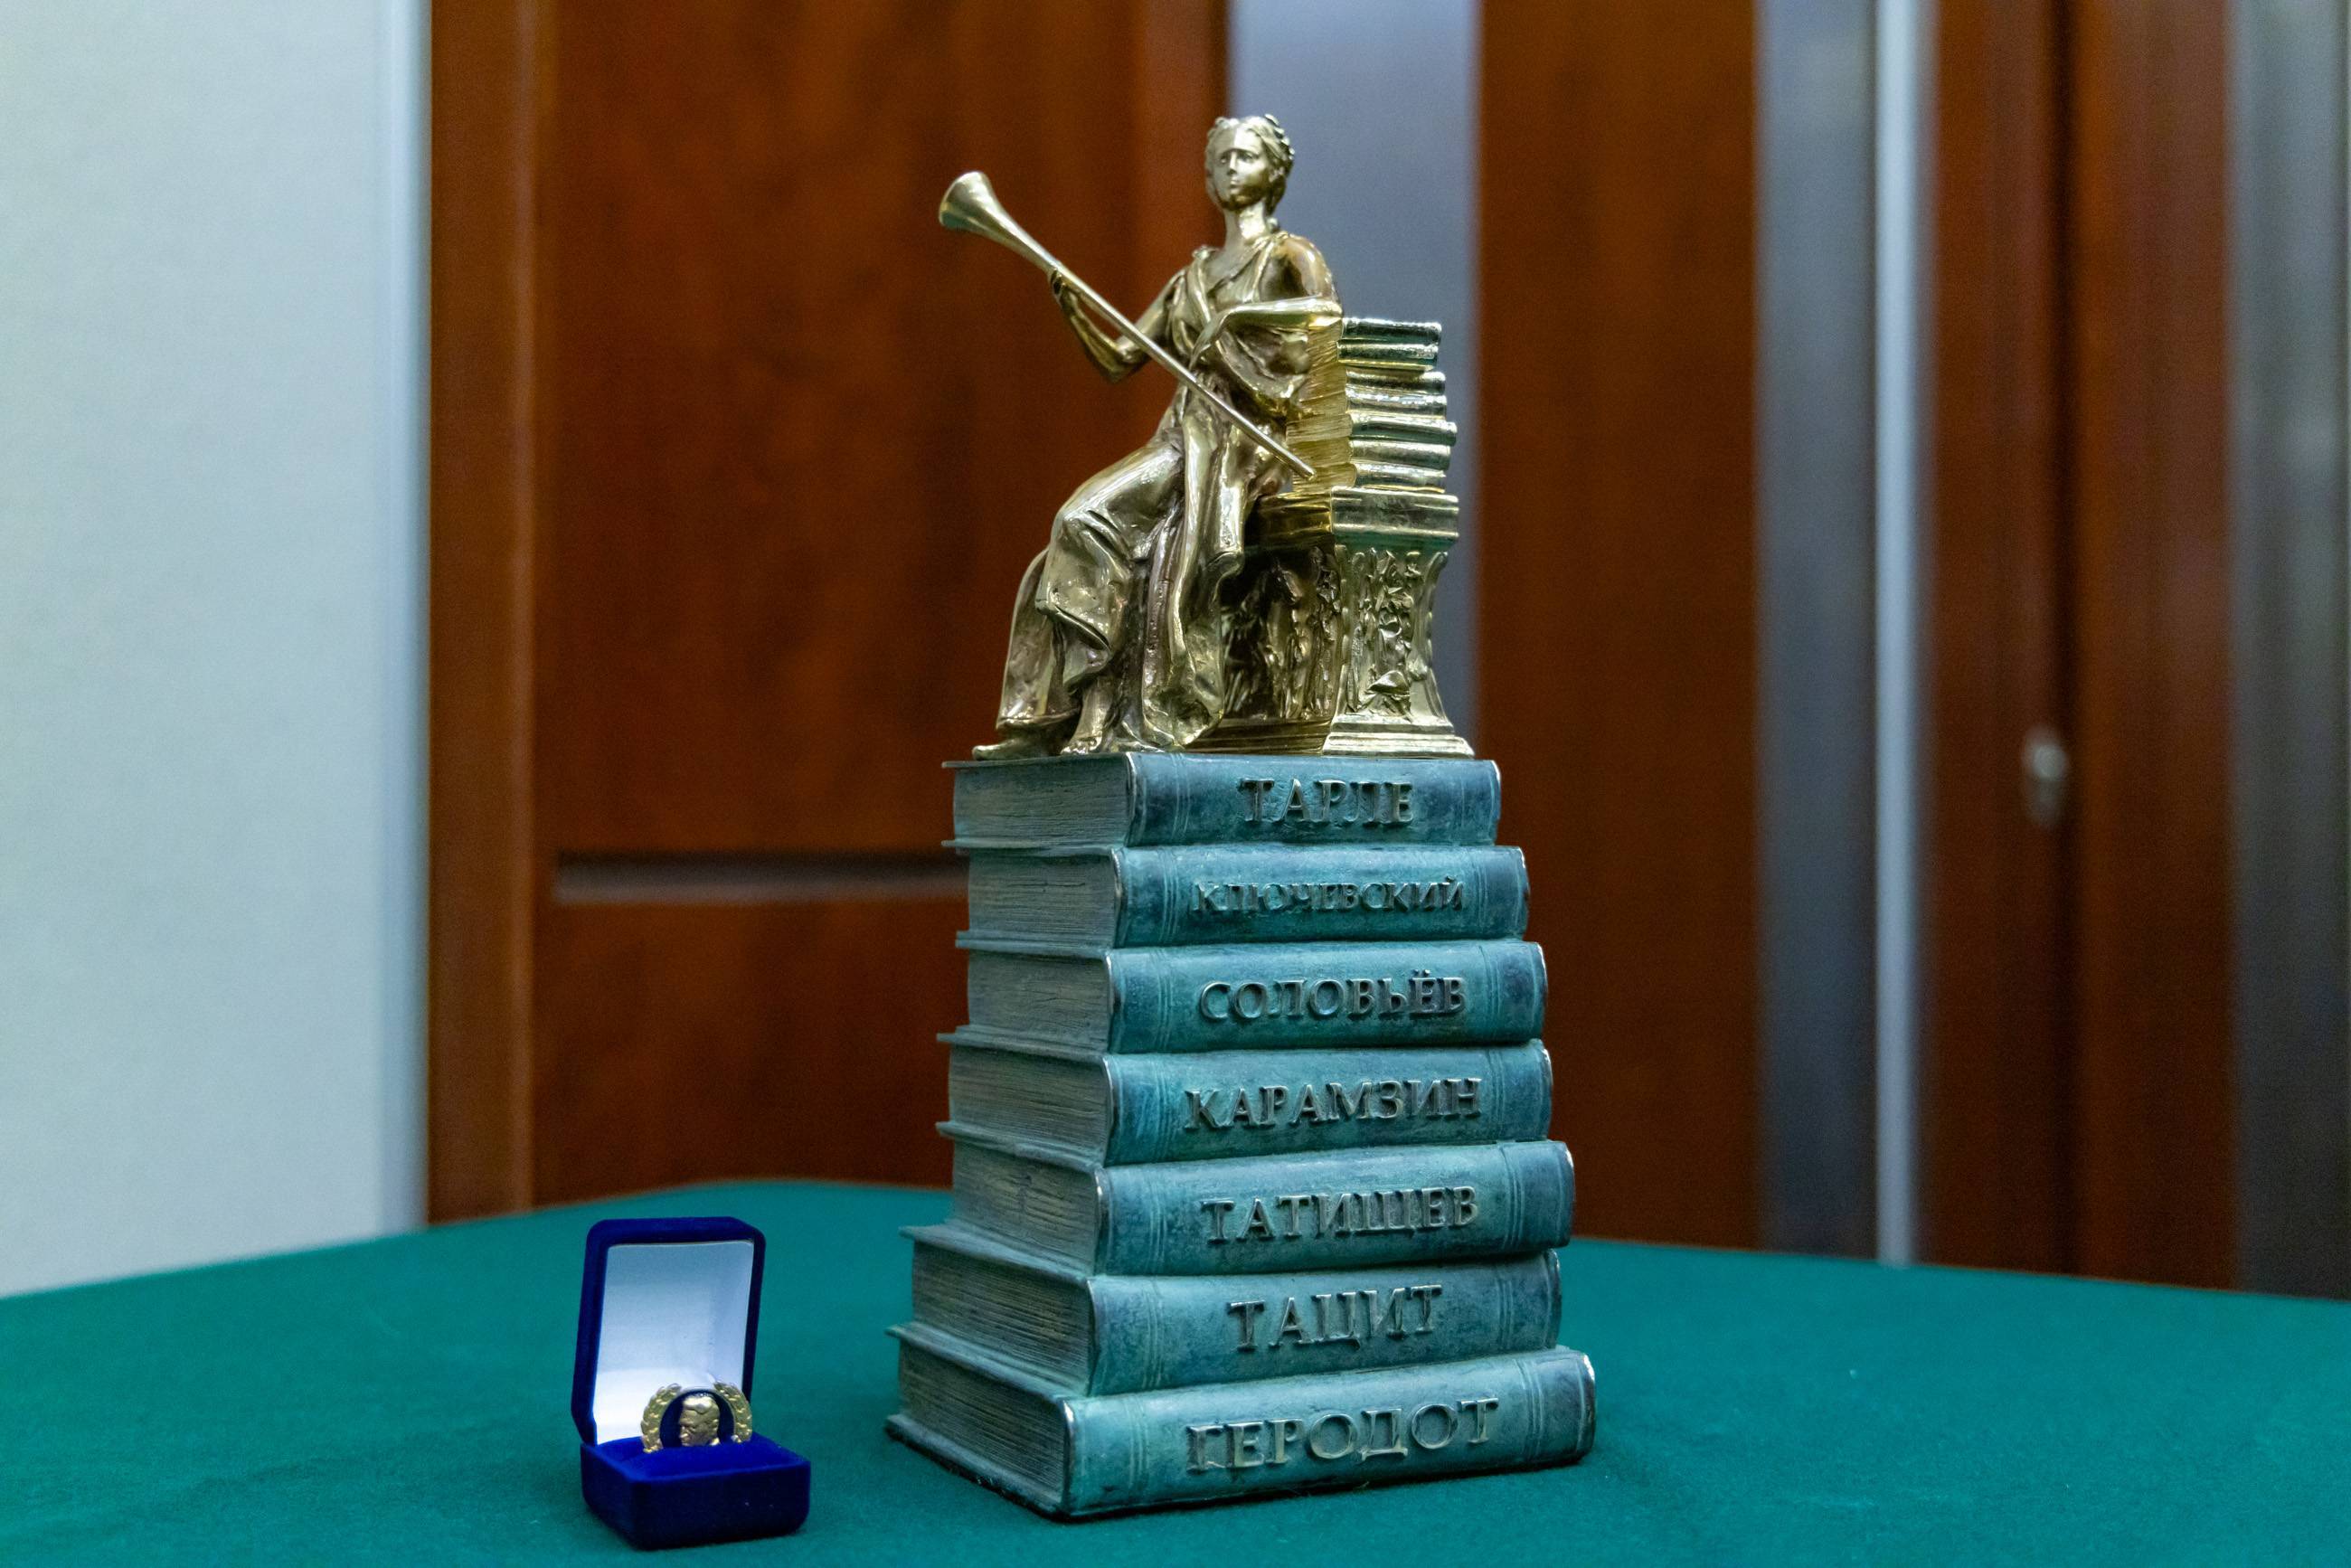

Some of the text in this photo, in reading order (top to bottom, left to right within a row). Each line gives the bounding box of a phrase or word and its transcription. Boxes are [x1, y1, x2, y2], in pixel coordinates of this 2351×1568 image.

[1238, 778, 1414, 824] ТАРЛЕ
[1193, 876, 1464, 912] КЛЮЧЕВСКИЙ
[1200, 970, 1467, 1021] СОЛОВЬЁВ
[1185, 1077, 1482, 1129] КАРАМЗИН
[1200, 1185, 1478, 1243] ТАТИЩЕВ
[1226, 1284, 1442, 1353] ТАЦИТ
[1185, 1397, 1499, 1472] ГЕРОДОТ
